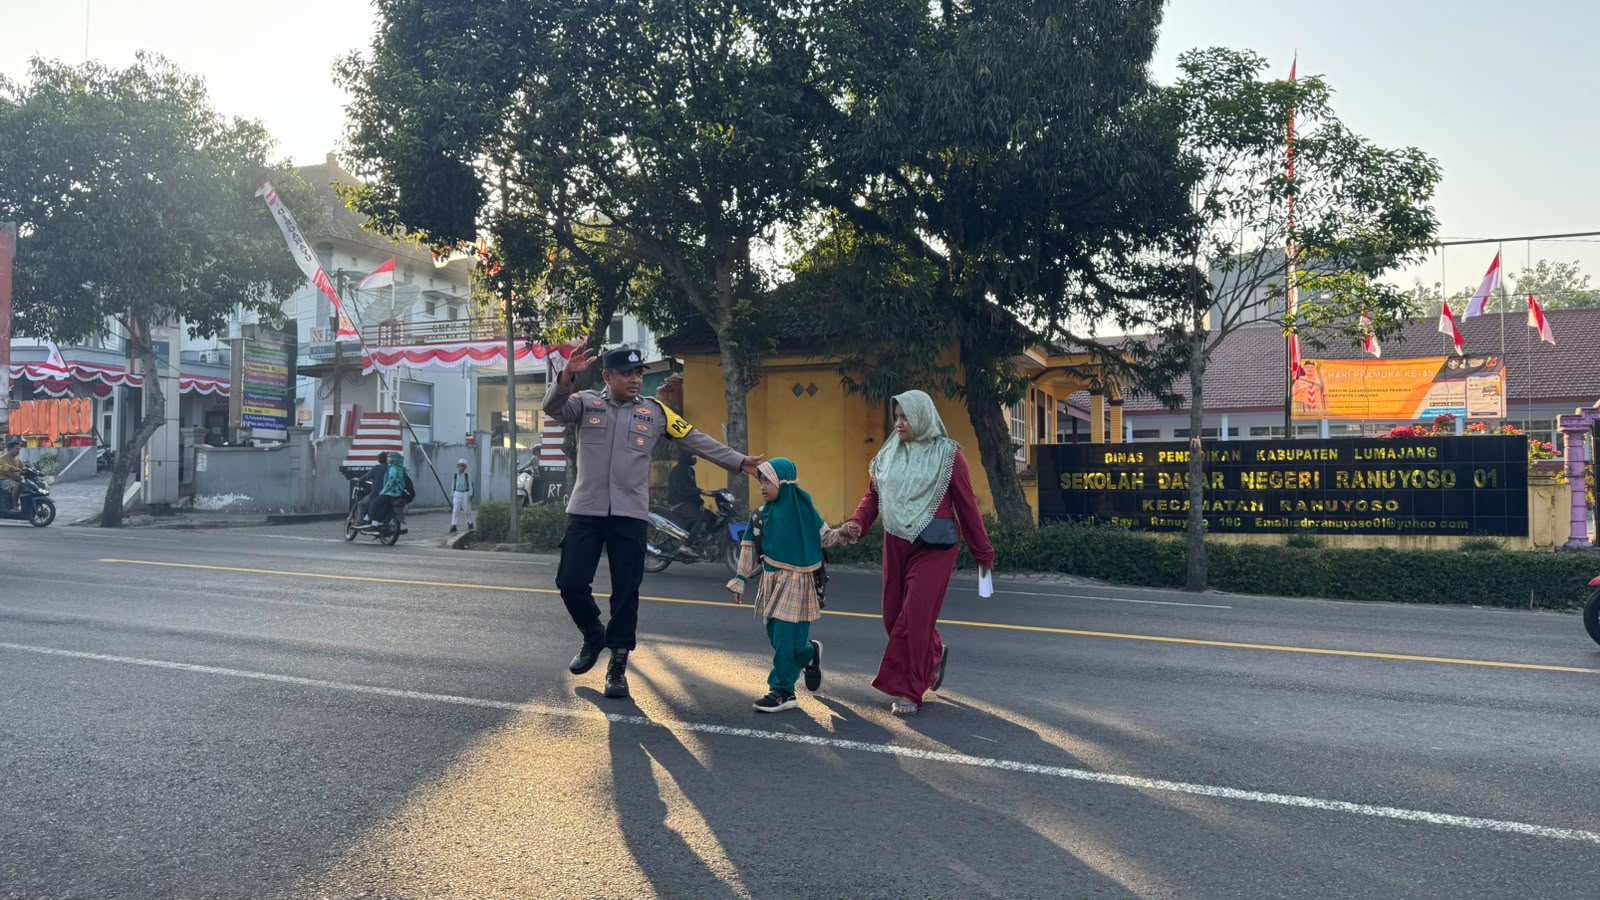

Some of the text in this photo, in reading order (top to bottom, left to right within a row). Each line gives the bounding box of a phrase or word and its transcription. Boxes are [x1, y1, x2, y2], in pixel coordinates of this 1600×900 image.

[1328, 371, 1351, 379] HARI
[1354, 370, 1401, 379] PRAMUKA
[633, 414, 655, 424] POLRI
[1104, 452, 1144, 464] DINAS
[1256, 448, 1338, 462] KABUPATEN
[1354, 446, 1438, 461] LUMAJANG
[1060, 472, 1145, 490] SEKOLAH
[1240, 471, 1320, 490] NEGERI
[1335, 468, 1457, 490] RANUYOSO
[1473, 468, 1498, 489] 01
[547, 482, 563, 499] RT
[1279, 499, 1400, 512] RANUYOSO
